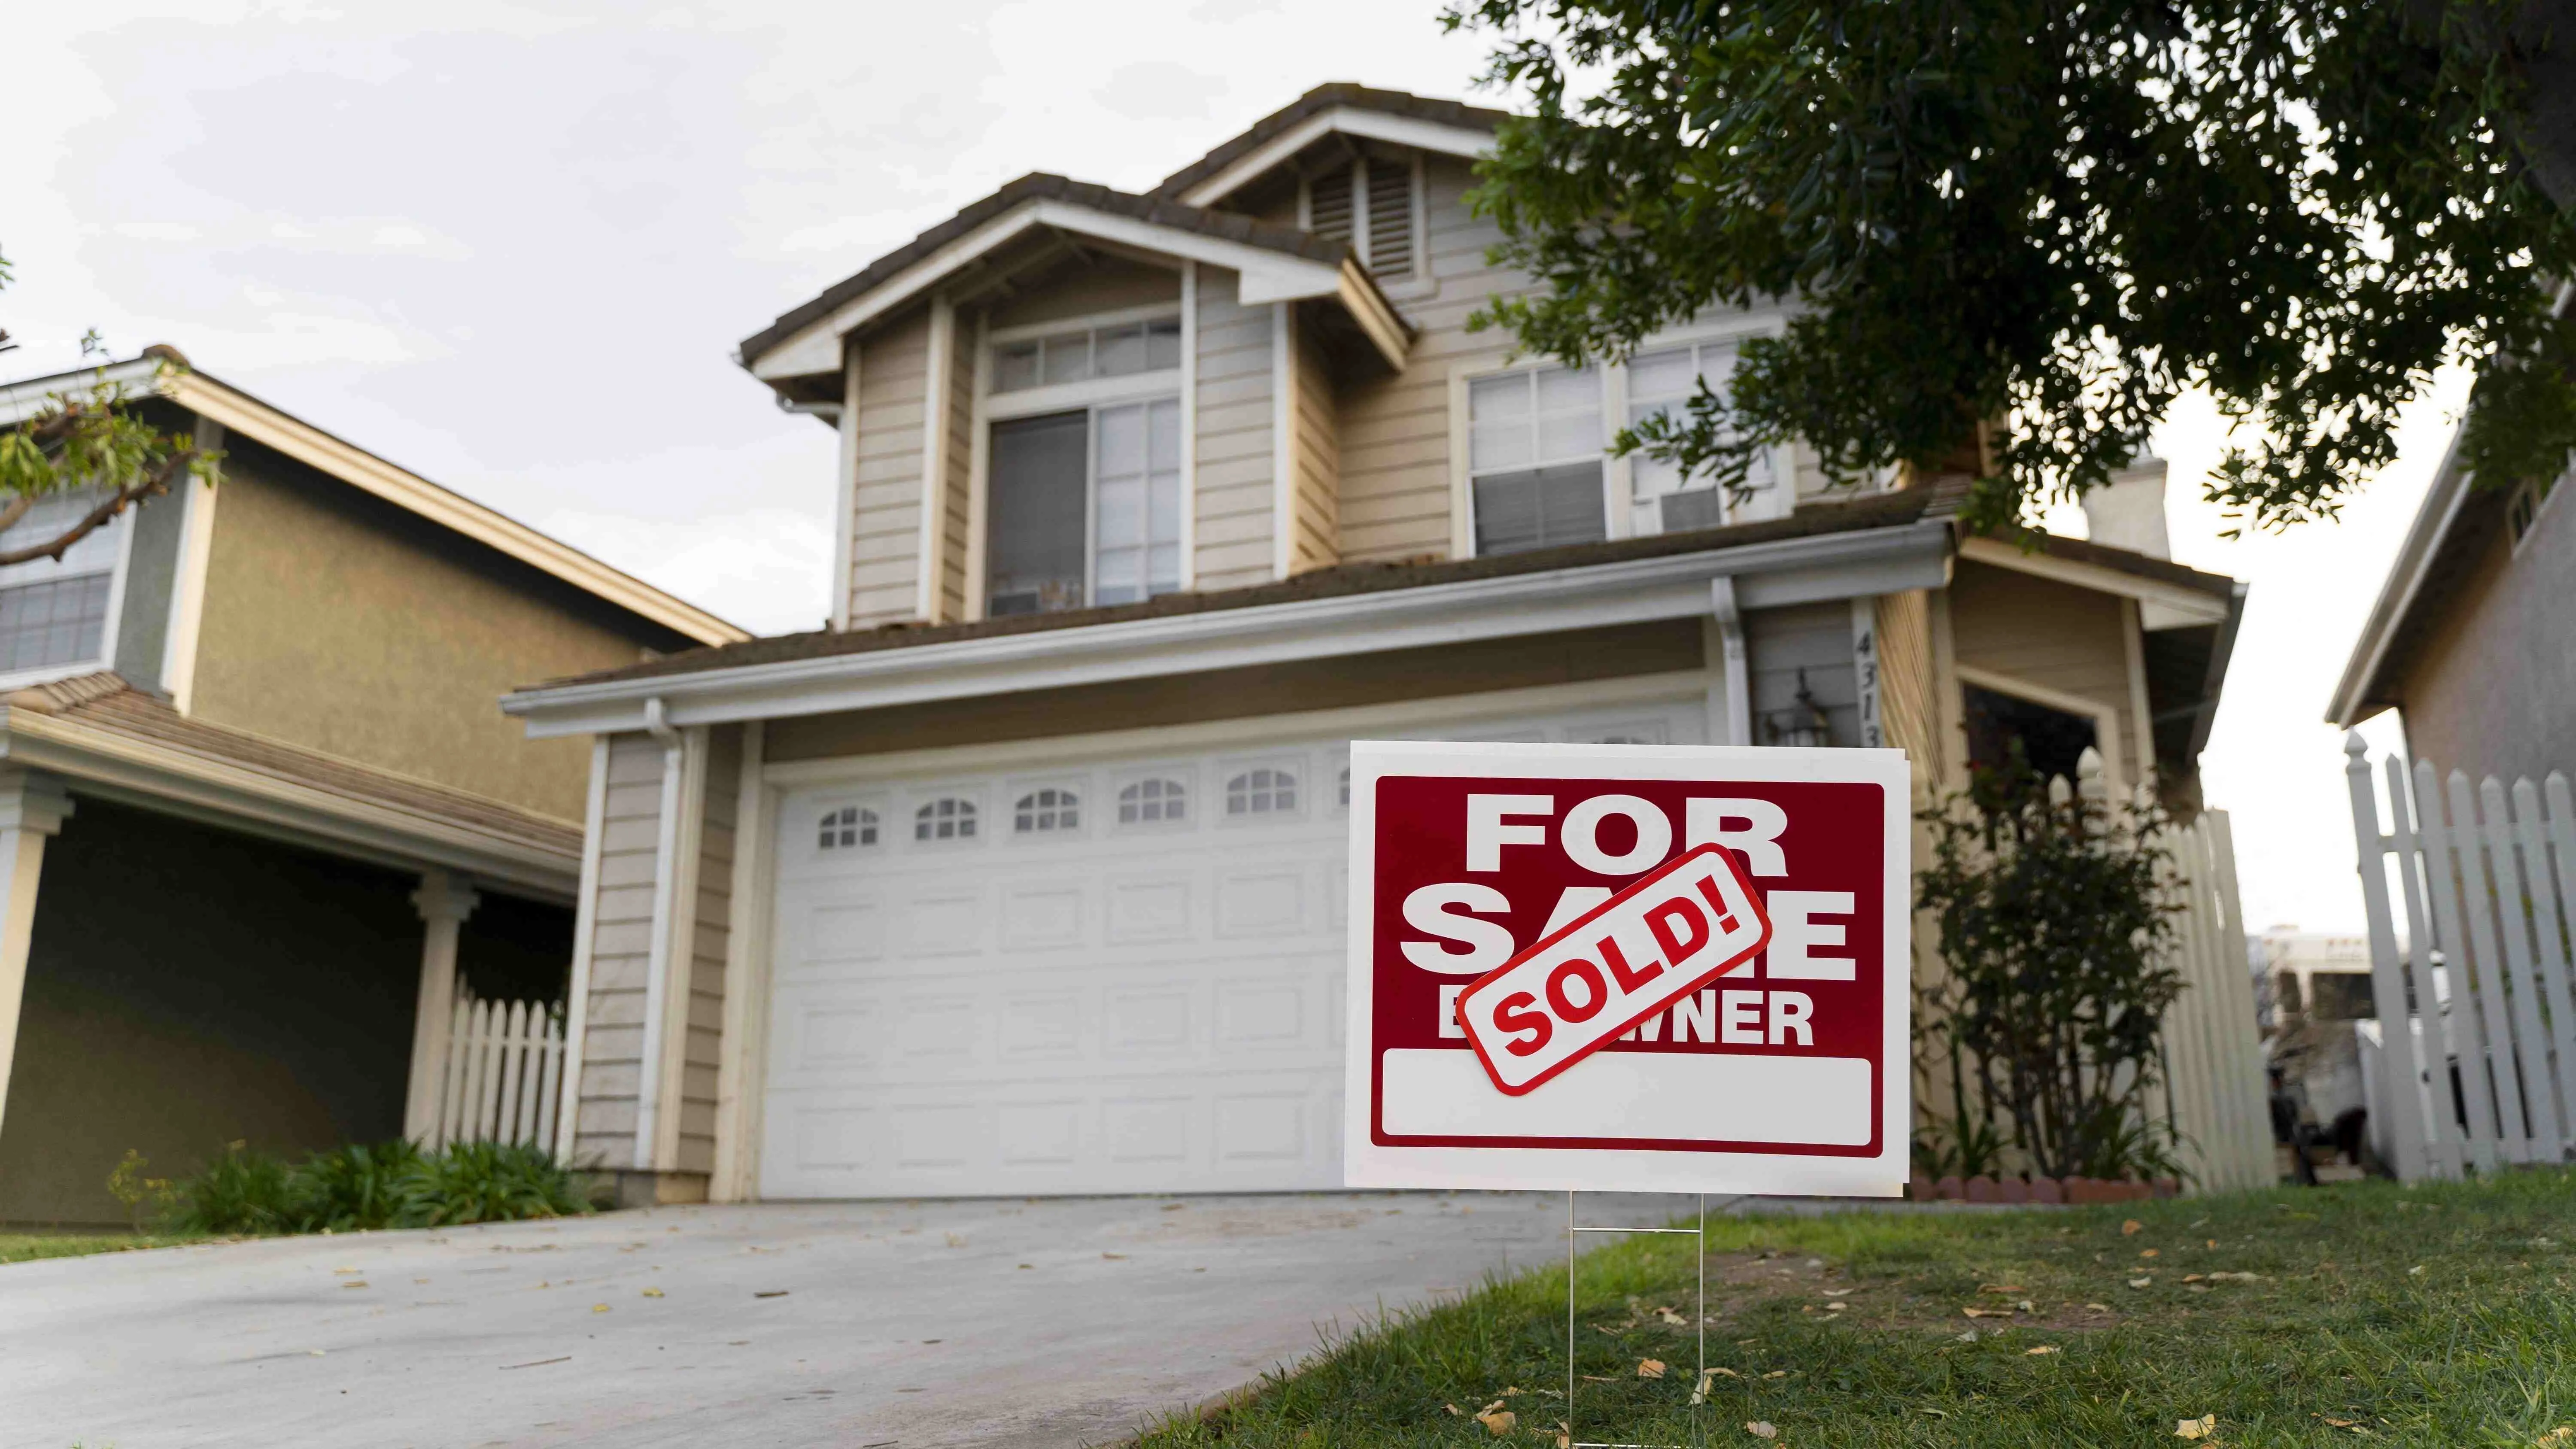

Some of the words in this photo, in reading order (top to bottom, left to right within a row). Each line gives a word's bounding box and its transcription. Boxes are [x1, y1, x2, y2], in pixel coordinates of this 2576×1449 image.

[1466, 794, 1789, 876] FOR
[1400, 882, 1856, 981] SE
[1493, 874, 1740, 1057] SOLD!
